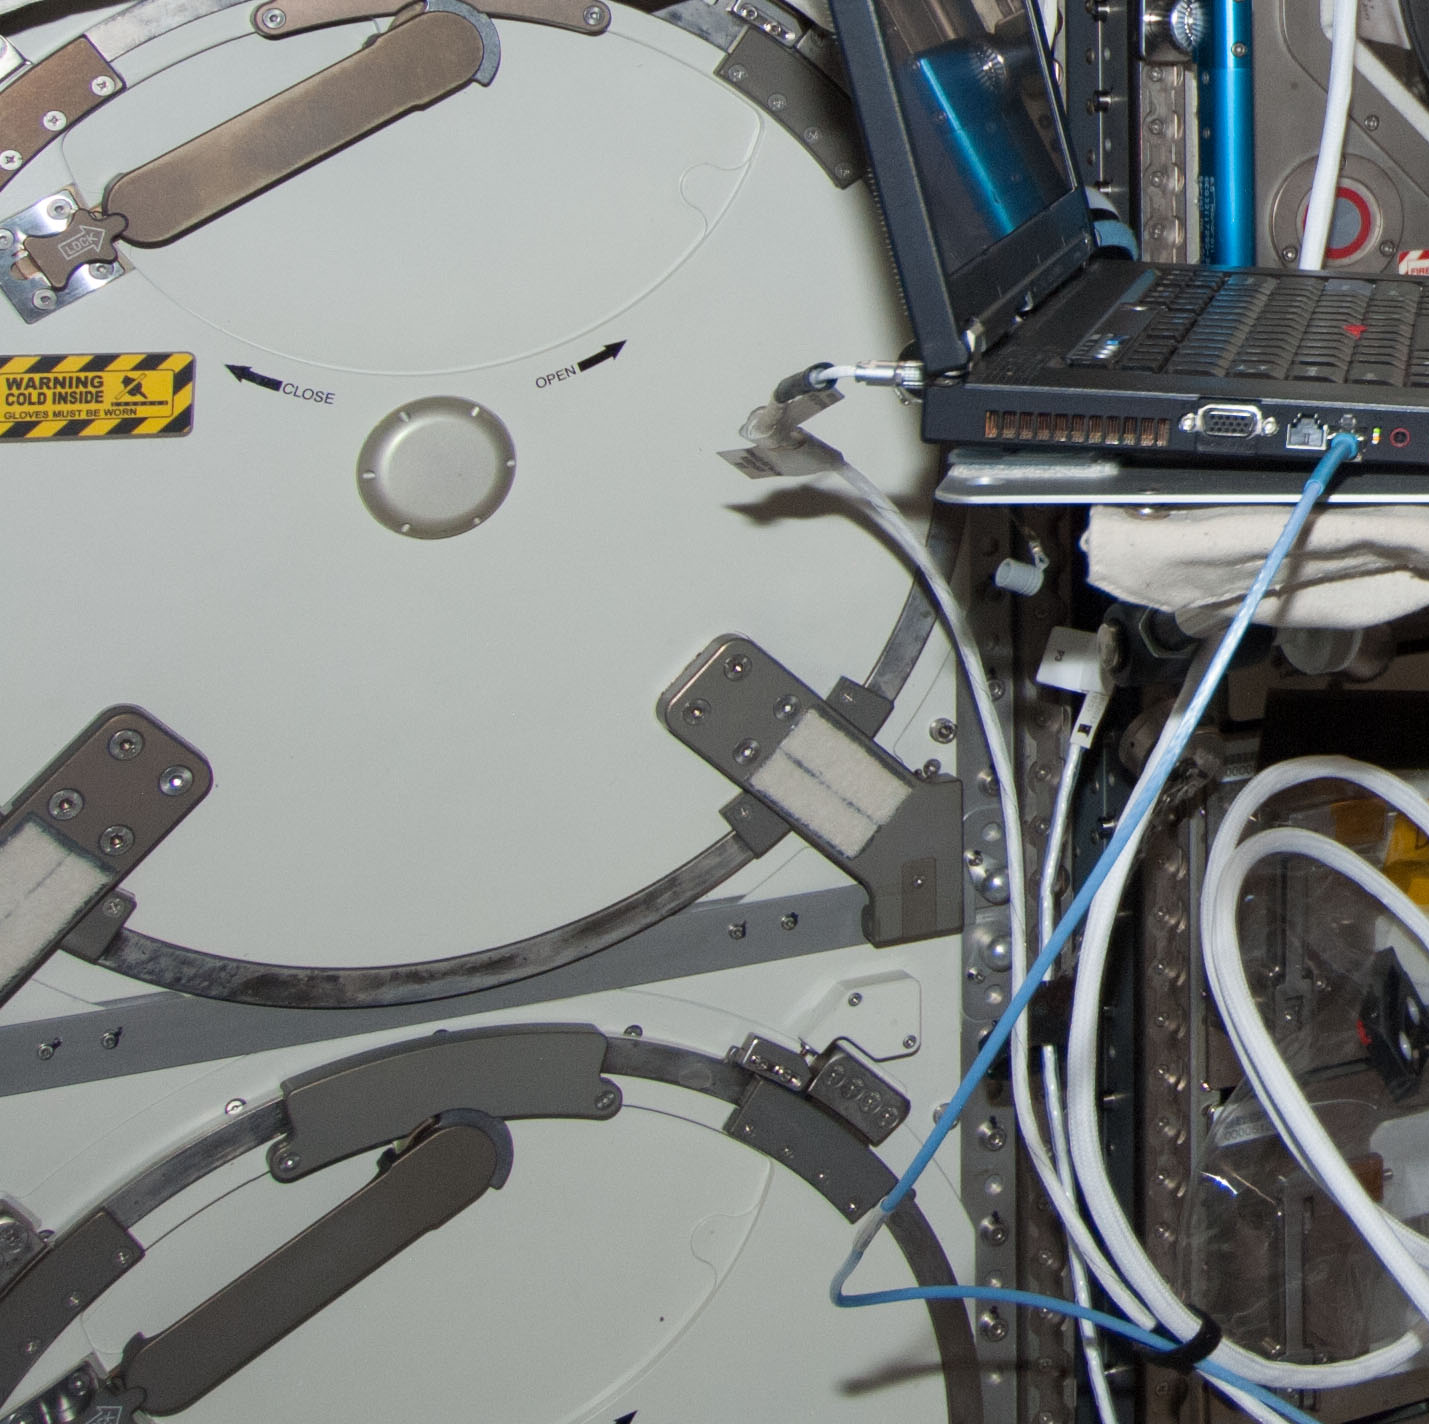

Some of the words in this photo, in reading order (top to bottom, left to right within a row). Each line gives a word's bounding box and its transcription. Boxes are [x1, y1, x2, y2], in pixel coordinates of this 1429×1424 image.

[65, 232, 98, 254] LOCK
[5, 374, 104, 391] WARNING
[534, 364, 577, 390] OPEN
[5, 391, 47, 407] COLD
[52, 390, 105, 405] INSIDE
[281, 381, 337, 406] CLOSE
[3, 410, 49, 420] GLOVES
[52, 409, 83, 419] MUST
[86, 408, 101, 417] BE
[104, 407, 138, 417] WORN
